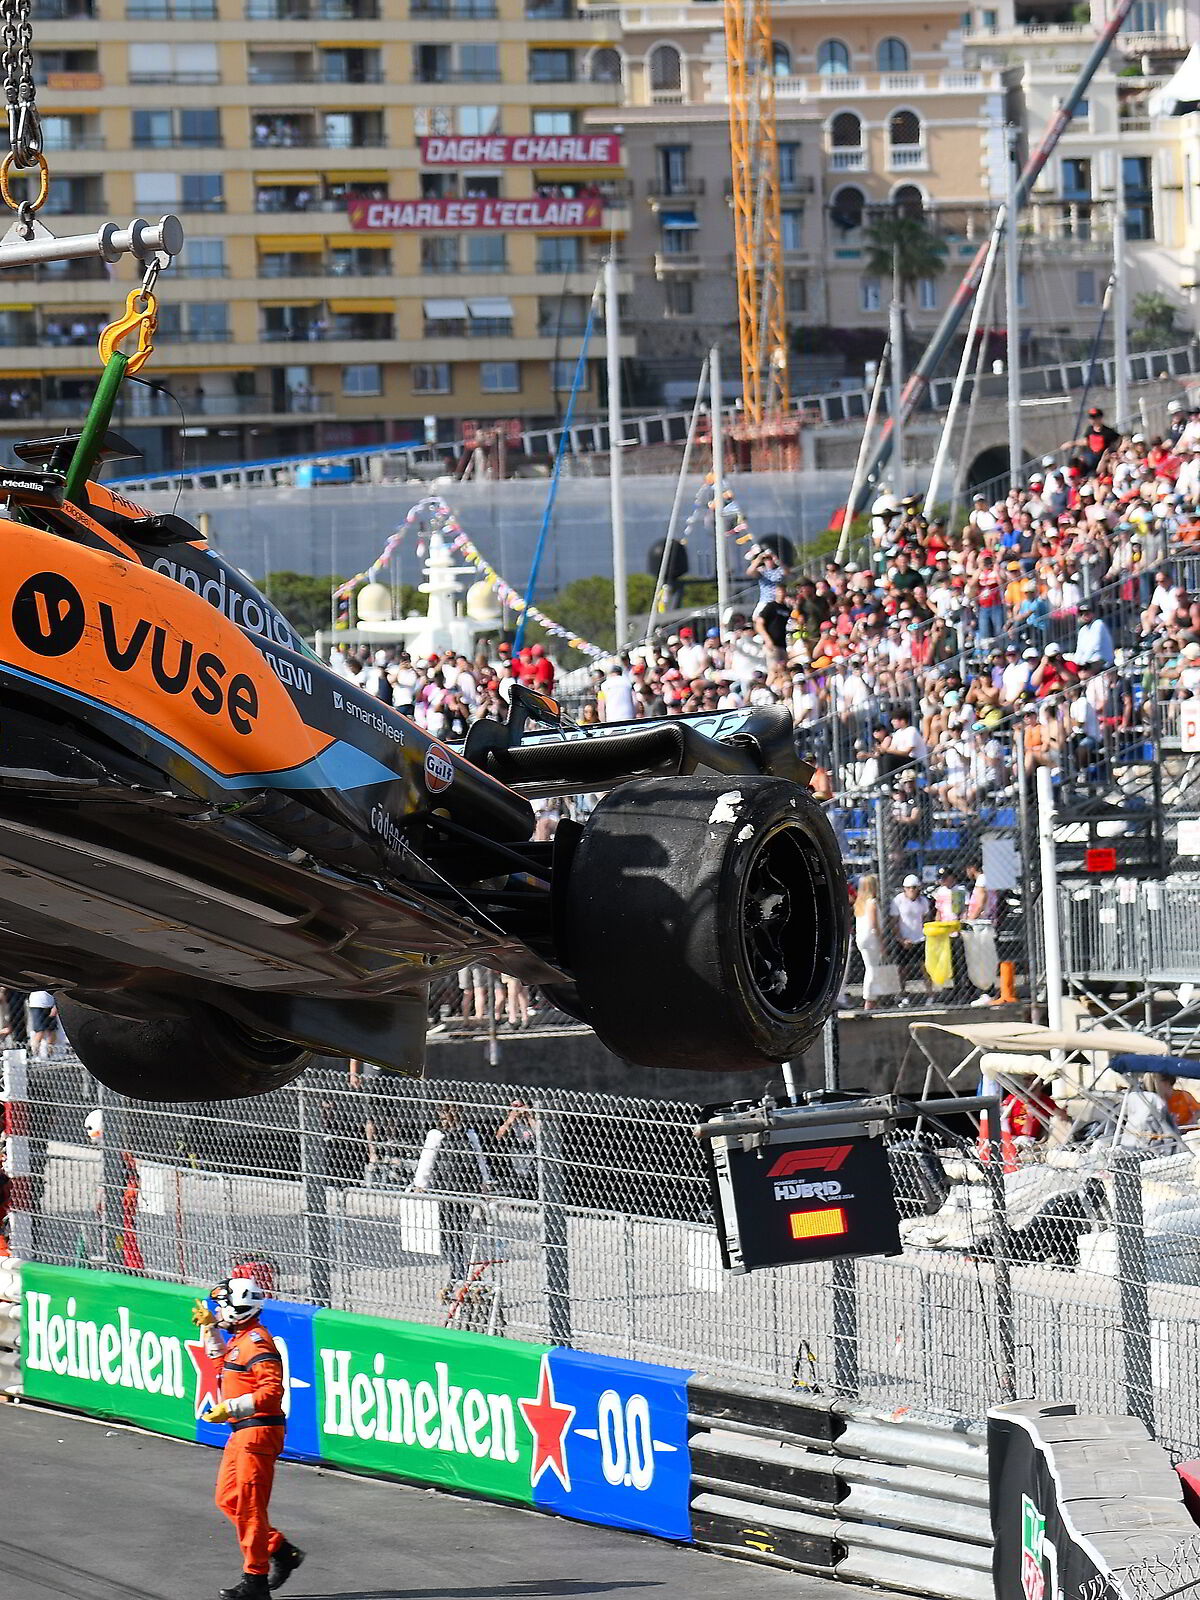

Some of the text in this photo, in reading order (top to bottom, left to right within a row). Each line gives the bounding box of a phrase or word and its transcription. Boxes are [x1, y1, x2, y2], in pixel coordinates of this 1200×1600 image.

[426, 137, 612, 161] DAGHE CHARLIE
[366, 202, 585, 227] CHARLES L'ECLAIR
[3, 479, 44, 492] Medallia
[346, 700, 405, 746] smartsheet
[427, 756, 453, 780] Gulf
[774, 1181, 841, 1202] HYBRID
[25, 1290, 185, 1399] Heineken
[319, 1348, 519, 1463] Heineken
